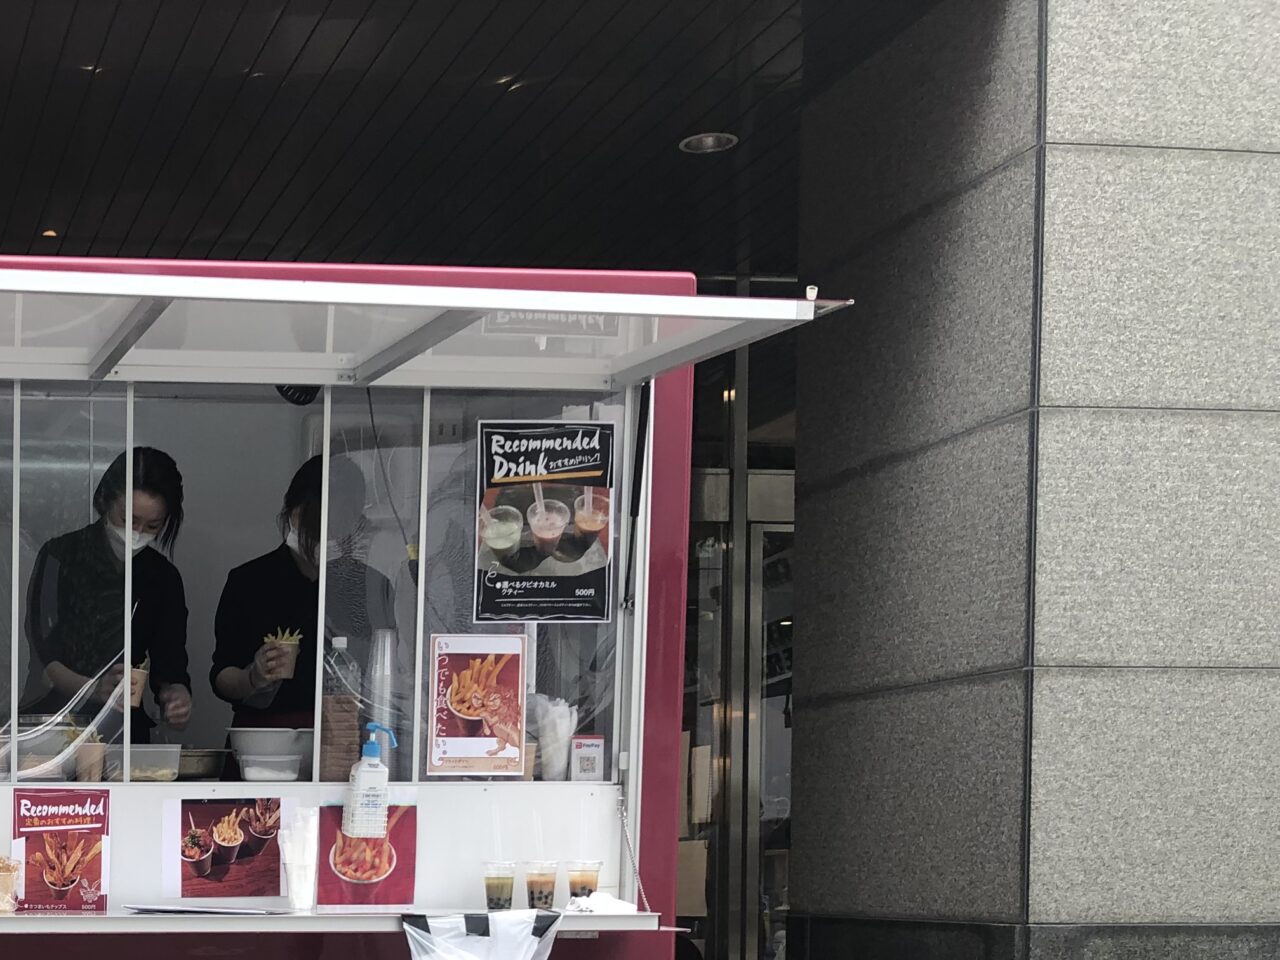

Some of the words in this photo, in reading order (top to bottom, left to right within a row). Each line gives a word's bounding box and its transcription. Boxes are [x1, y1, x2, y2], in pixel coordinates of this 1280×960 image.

[491, 430, 600, 454] Recommended
[493, 452, 548, 480] Drink
[575, 588, 595, 596] 500円
[20, 798, 104, 816] Recommended
